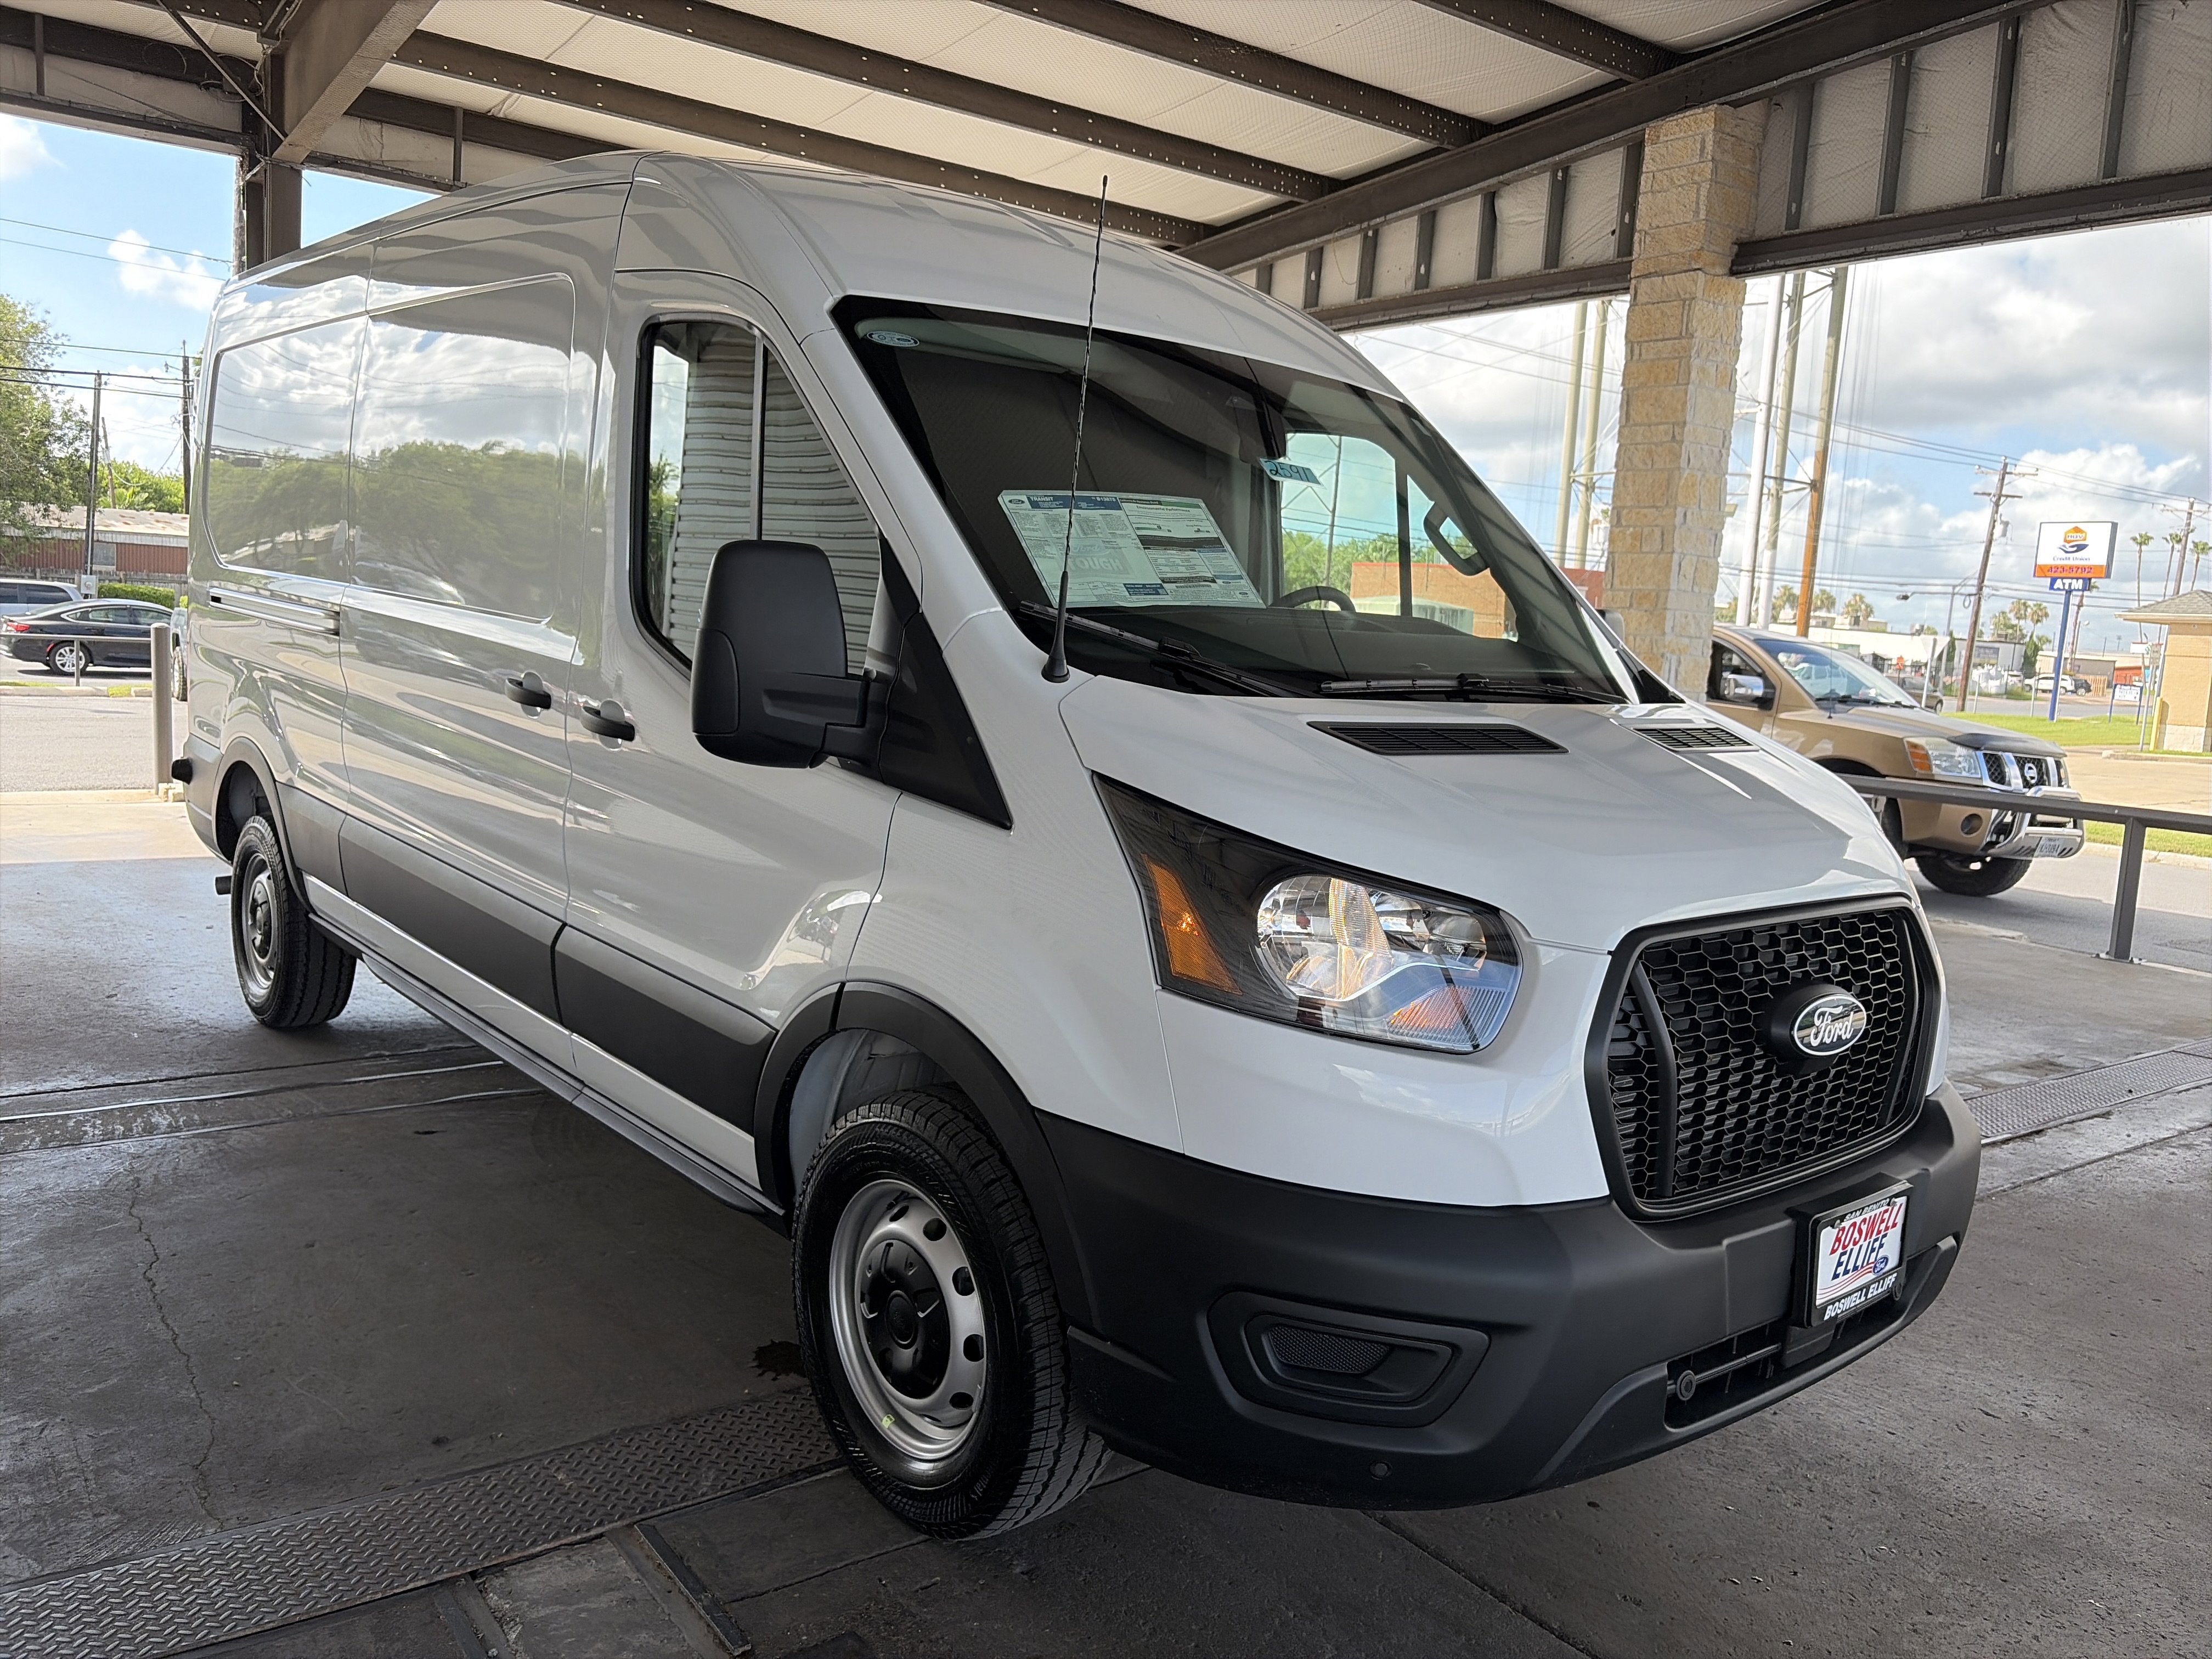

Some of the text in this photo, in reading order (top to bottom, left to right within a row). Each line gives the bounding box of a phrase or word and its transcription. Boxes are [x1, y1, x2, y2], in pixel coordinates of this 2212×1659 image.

[1263, 460, 1310, 482] 2591
[2053, 578, 2083, 590] ATM
[1810, 1006, 1854, 1046] Ford
[1829, 1203, 1903, 1256] BOSWELL
[1844, 1198, 1890, 1222] SAN BENITO
[1831, 1232, 1889, 1282] ELLIFF
[1824, 1272, 1898, 1321] BOSWELL ELLIFF
